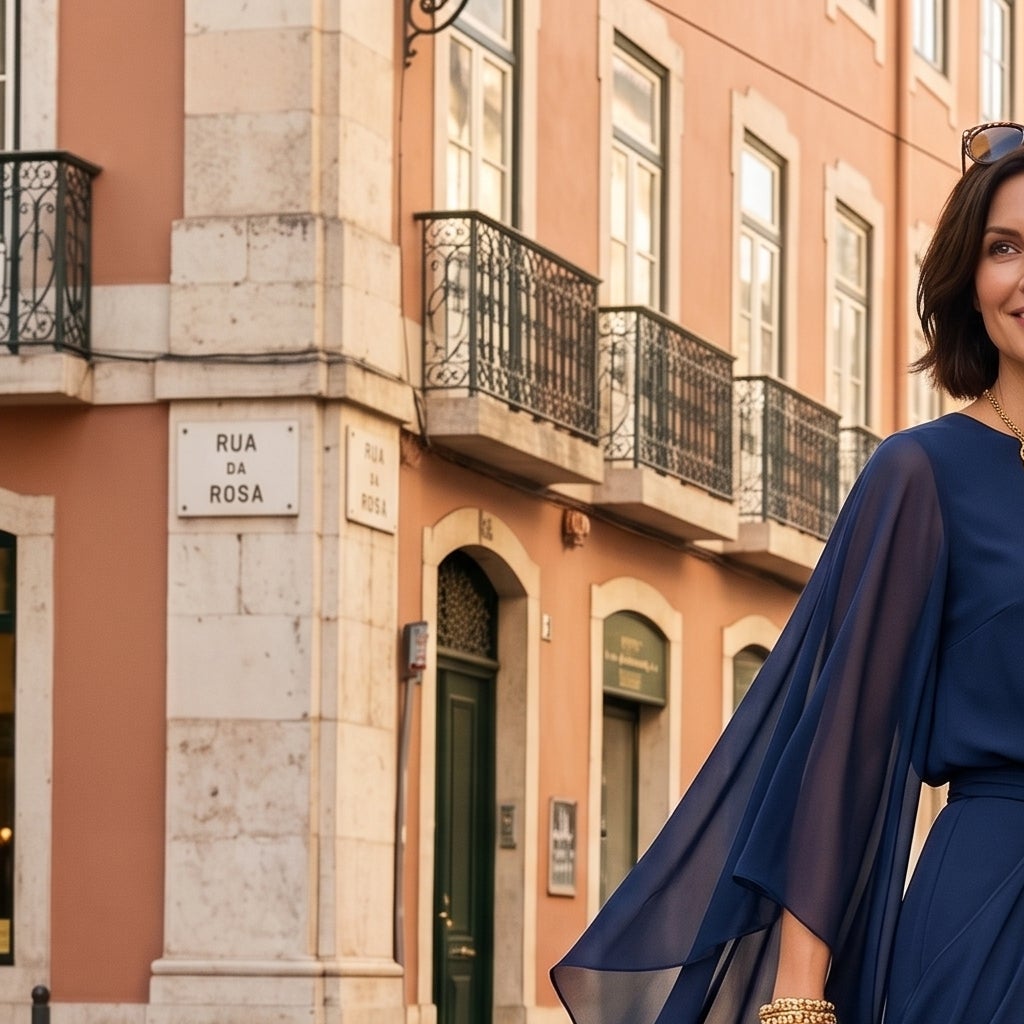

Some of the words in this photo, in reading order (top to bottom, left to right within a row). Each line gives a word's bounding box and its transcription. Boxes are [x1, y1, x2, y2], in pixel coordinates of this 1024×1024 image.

[216, 433, 257, 452] RUA
[364, 442, 385, 465] RUA
[227, 462, 246, 475] DA
[210, 484, 264, 503] ROSA
[361, 492, 387, 518] ROSA
